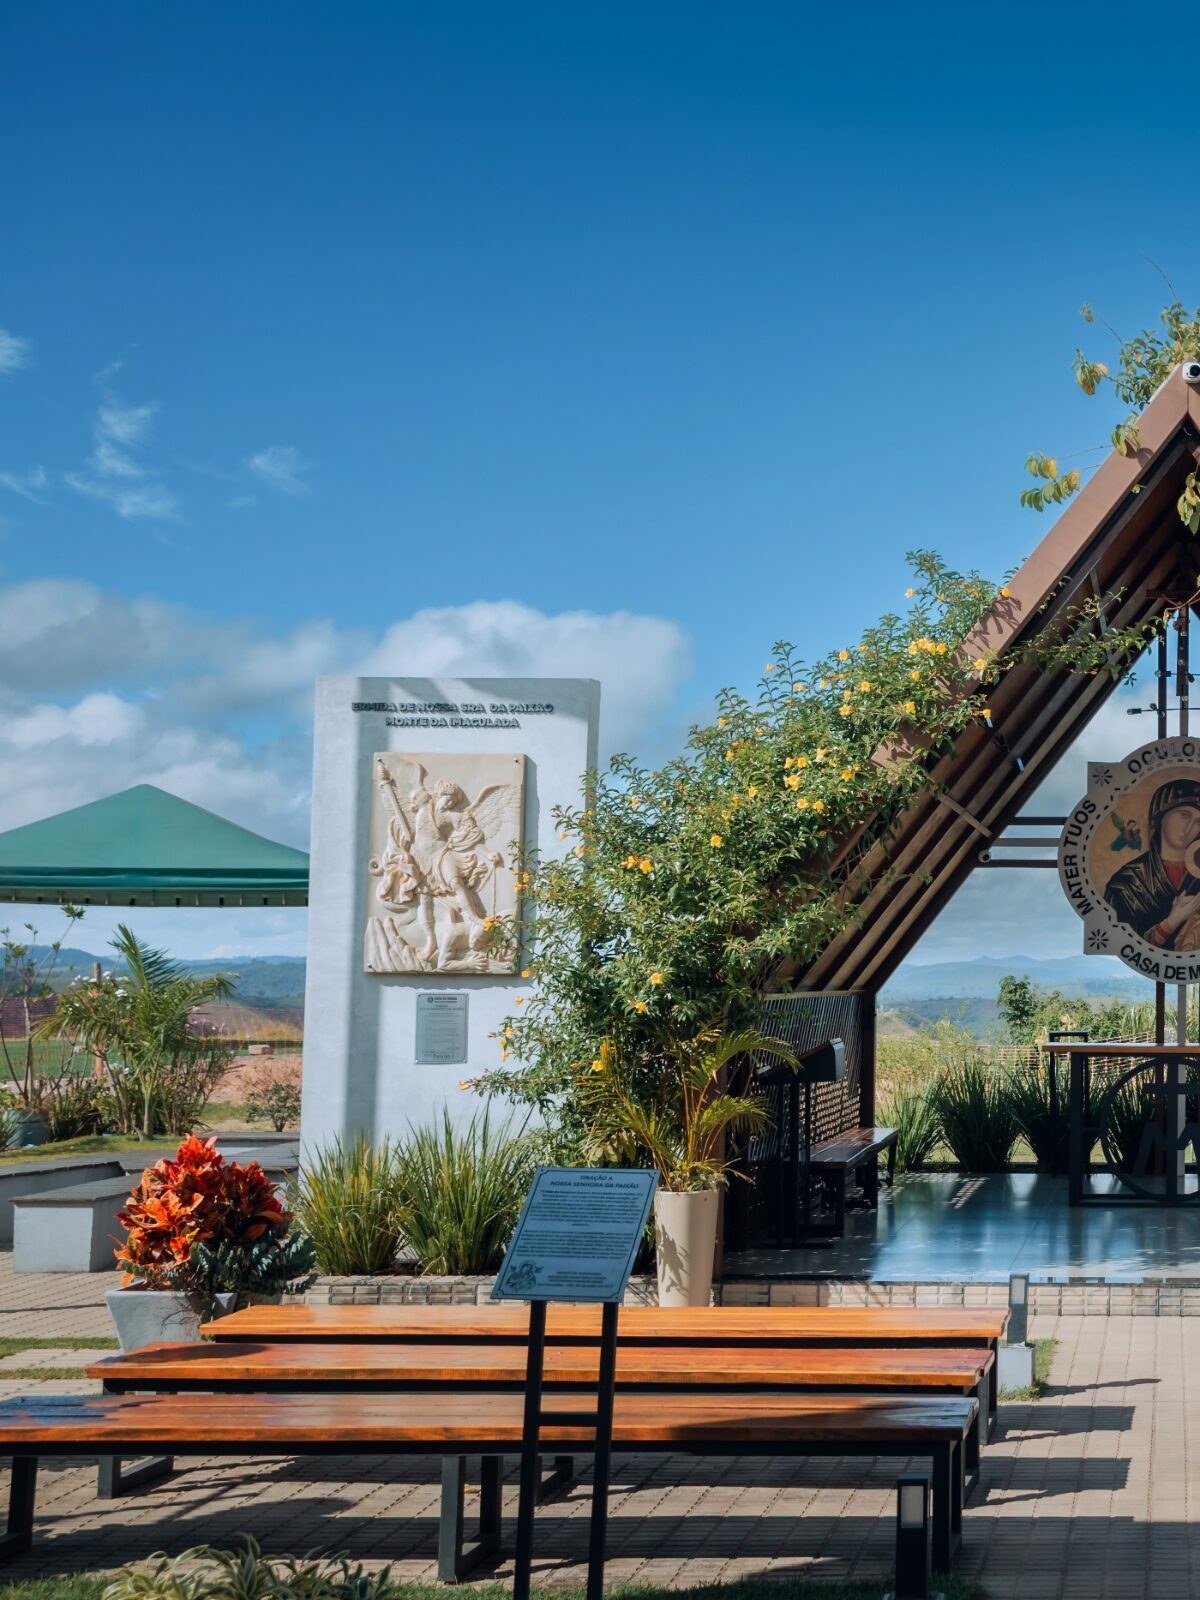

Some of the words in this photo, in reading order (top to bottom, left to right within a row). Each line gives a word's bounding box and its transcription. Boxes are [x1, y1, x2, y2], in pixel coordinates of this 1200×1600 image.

[351, 702, 398, 713] ERMIDA
[399, 702, 418, 713] DE
[418, 702, 460, 713] NOSSA
[461, 703, 487, 713] SRA
[489, 703, 509, 713] DA
[386, 717, 430, 727] MONTE
[430, 718, 450, 727] DA
[450, 718, 521, 728] IMACULADA
[1063, 800, 1097, 847] TUOS
[1064, 854, 1094, 916] MATER
[1120, 944, 1160, 977] CASA
[1163, 965, 1186, 980] DE
